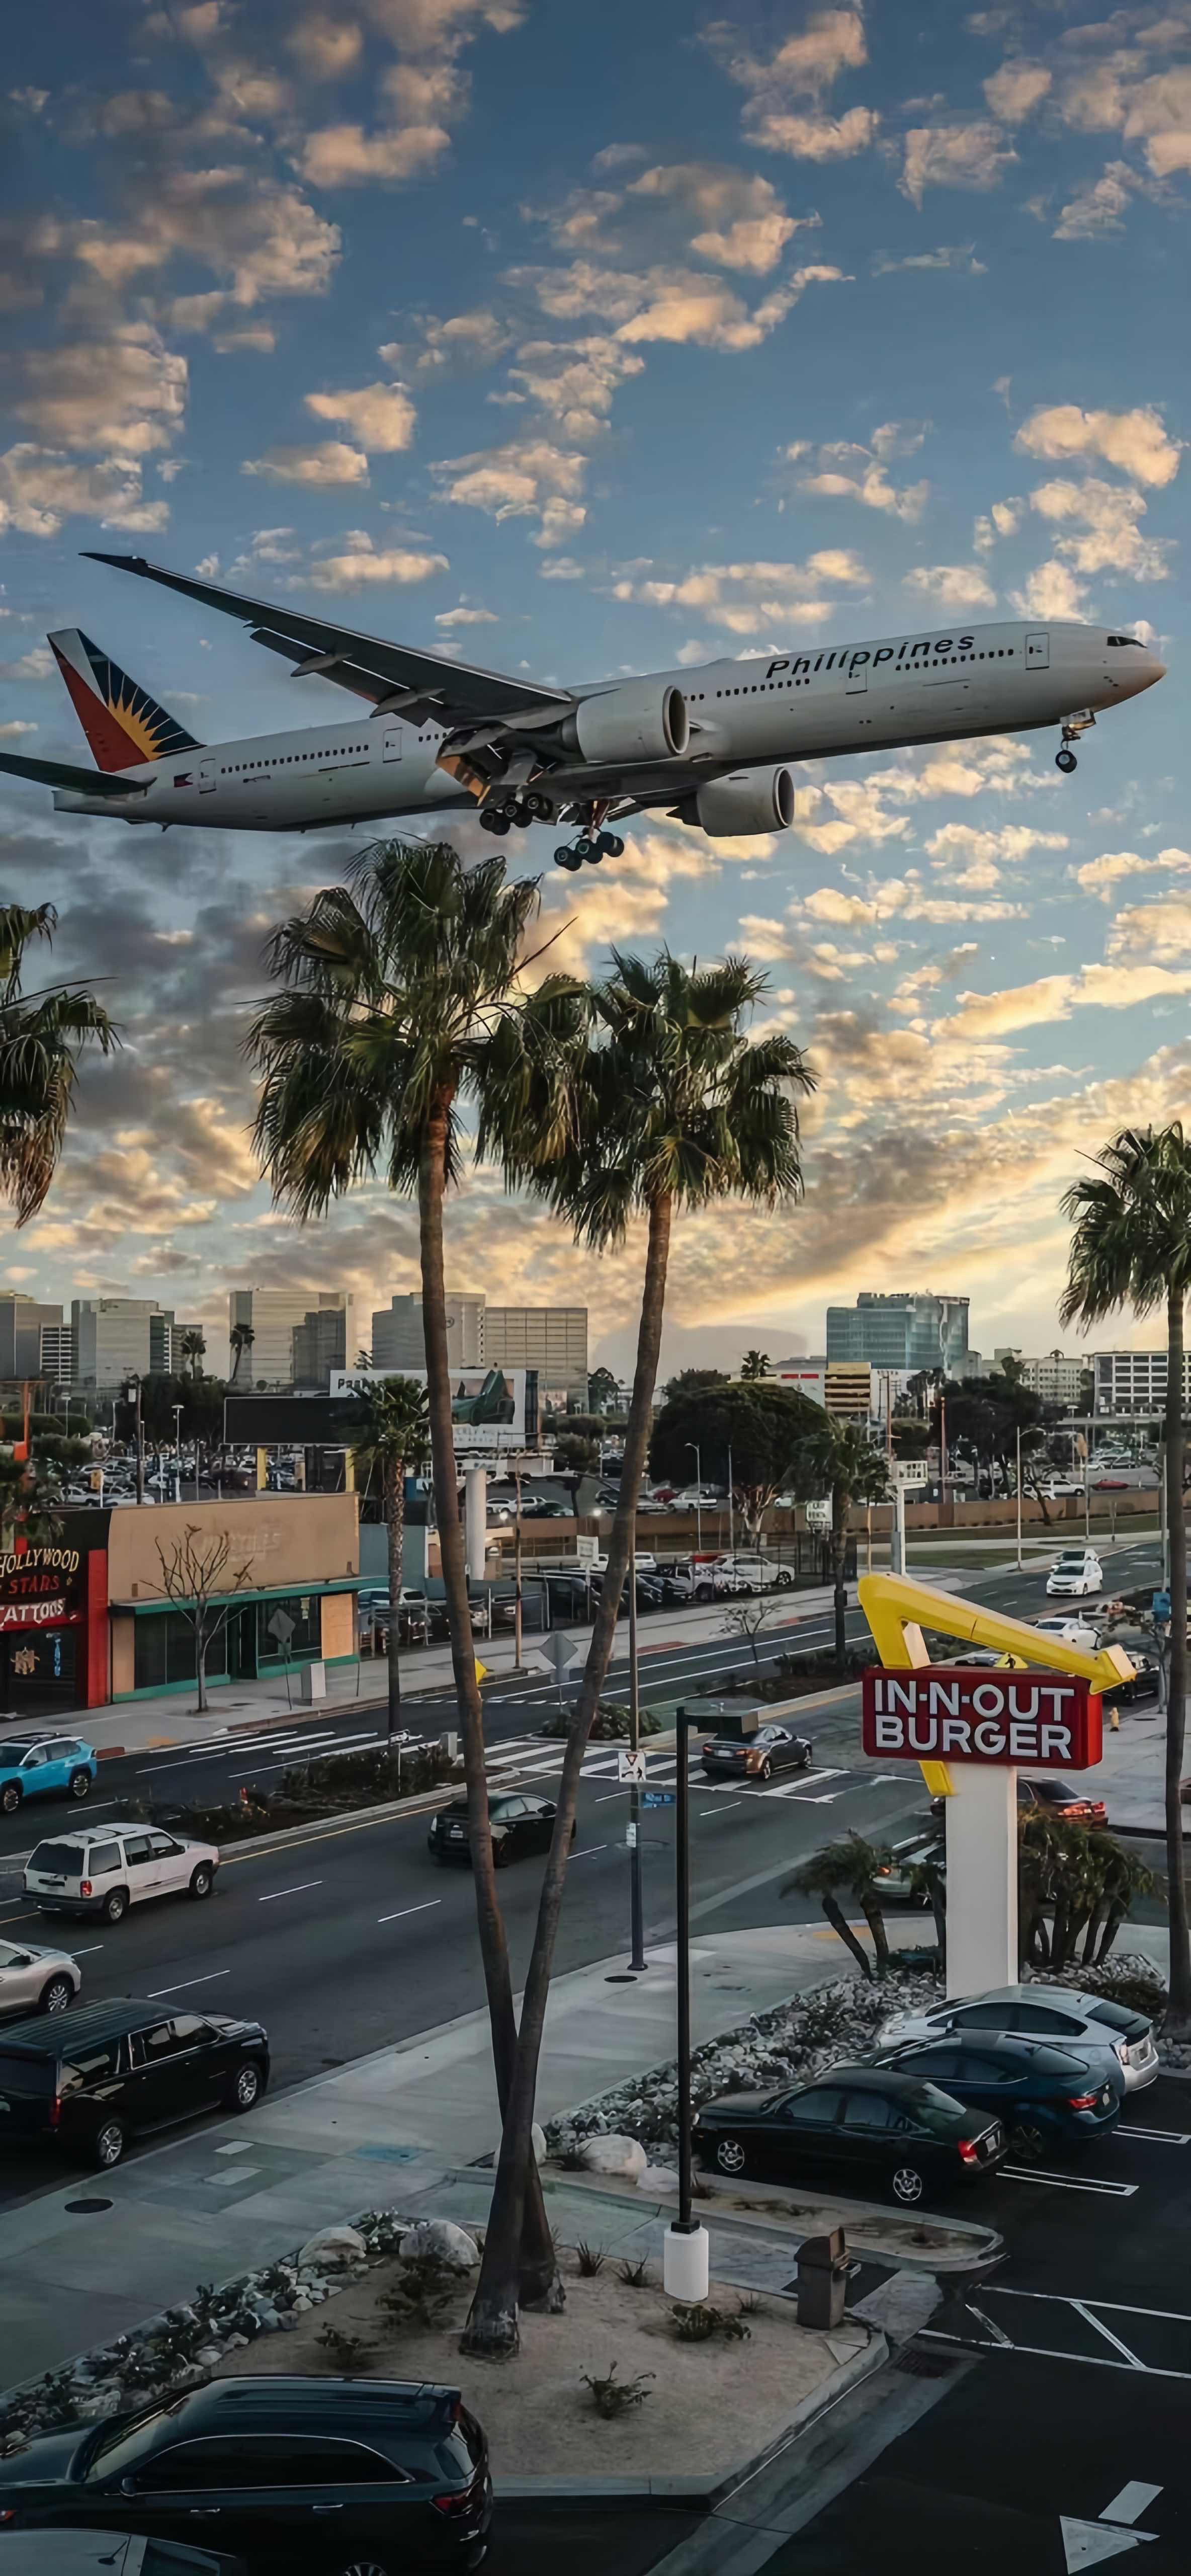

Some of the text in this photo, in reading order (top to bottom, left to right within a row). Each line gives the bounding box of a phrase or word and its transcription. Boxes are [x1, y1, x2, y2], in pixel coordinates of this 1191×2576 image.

[765, 636, 974, 678] Philippines
[9, 1575, 59, 1594] STARS
[876, 1715, 1072, 1759] BURGER
